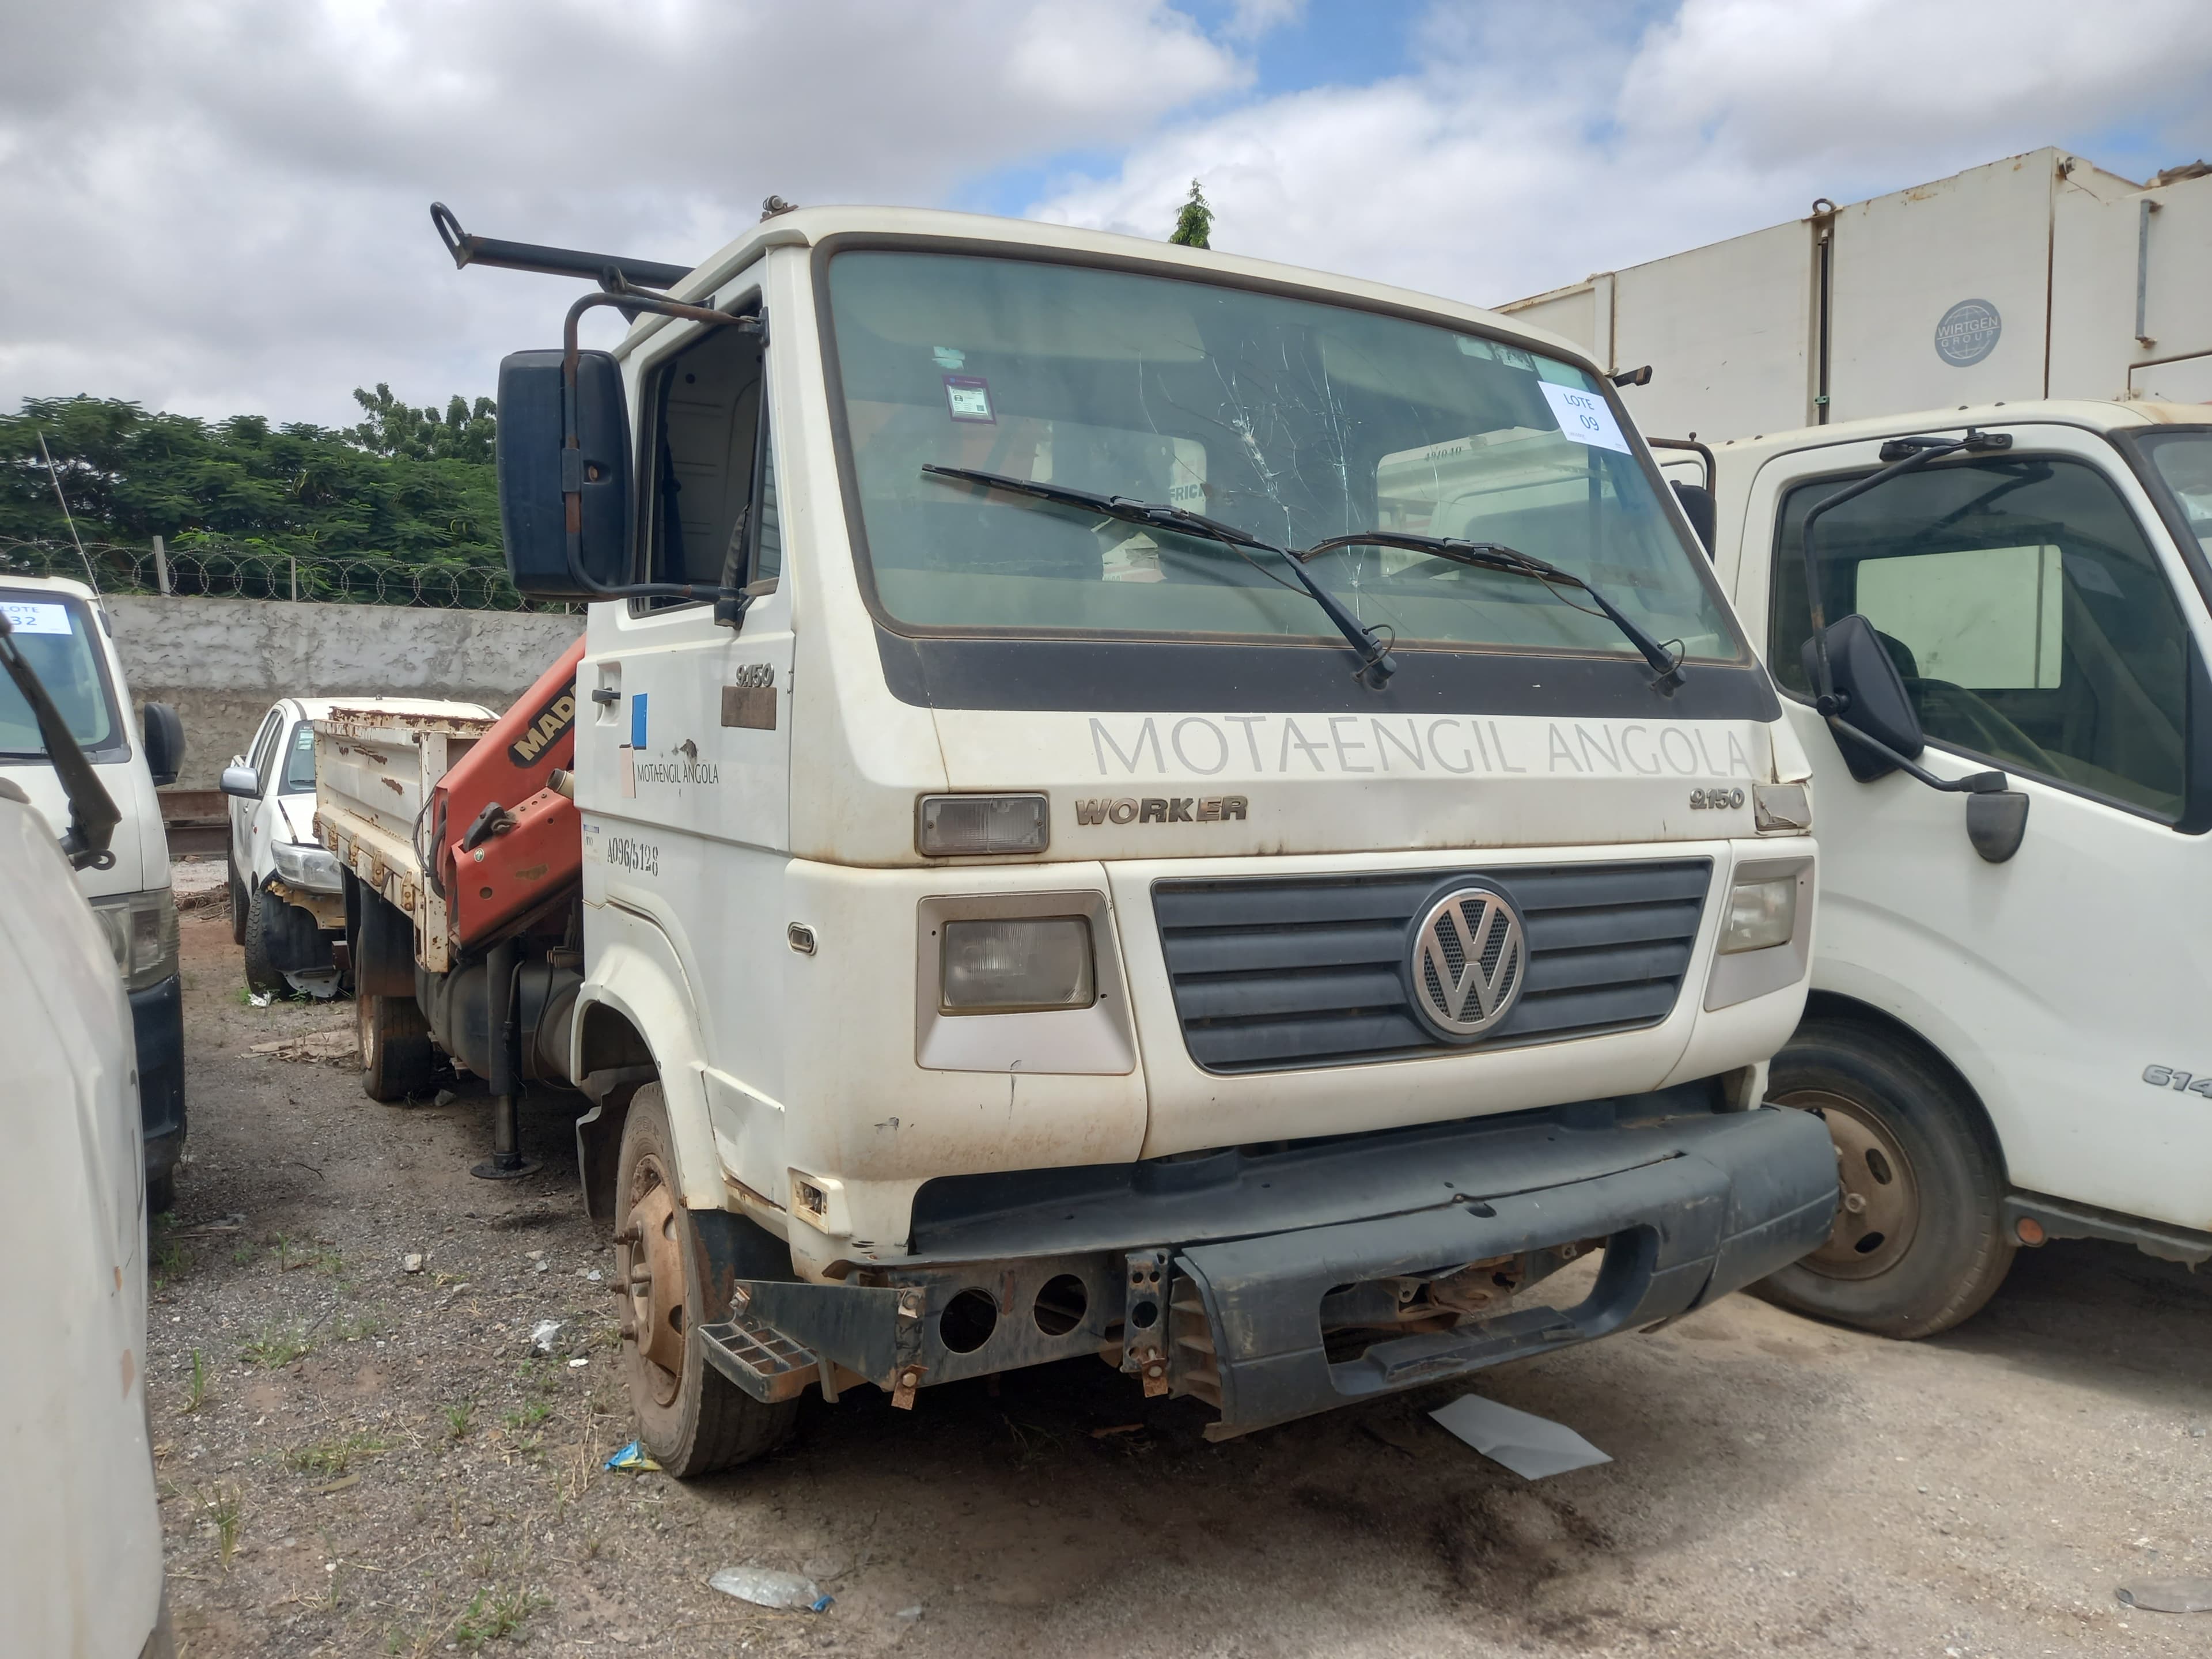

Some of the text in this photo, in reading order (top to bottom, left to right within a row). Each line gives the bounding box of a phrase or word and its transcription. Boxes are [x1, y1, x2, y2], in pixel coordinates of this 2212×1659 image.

[1938, 316, 1998, 338] WIRTGEN
[1941, 330, 1993, 347] GROUP
[1563, 393, 1594, 410] LOTE
[1580, 414, 1600, 431] 09
[10, 616, 37, 626] 32
[513, 683, 576, 761] MAD
[1548, 722, 1754, 778] ANGOLA
[683, 763, 719, 784] ANGOLA
[1075, 795, 1248, 825] WORKER
[607, 837, 658, 876] A096/5128
